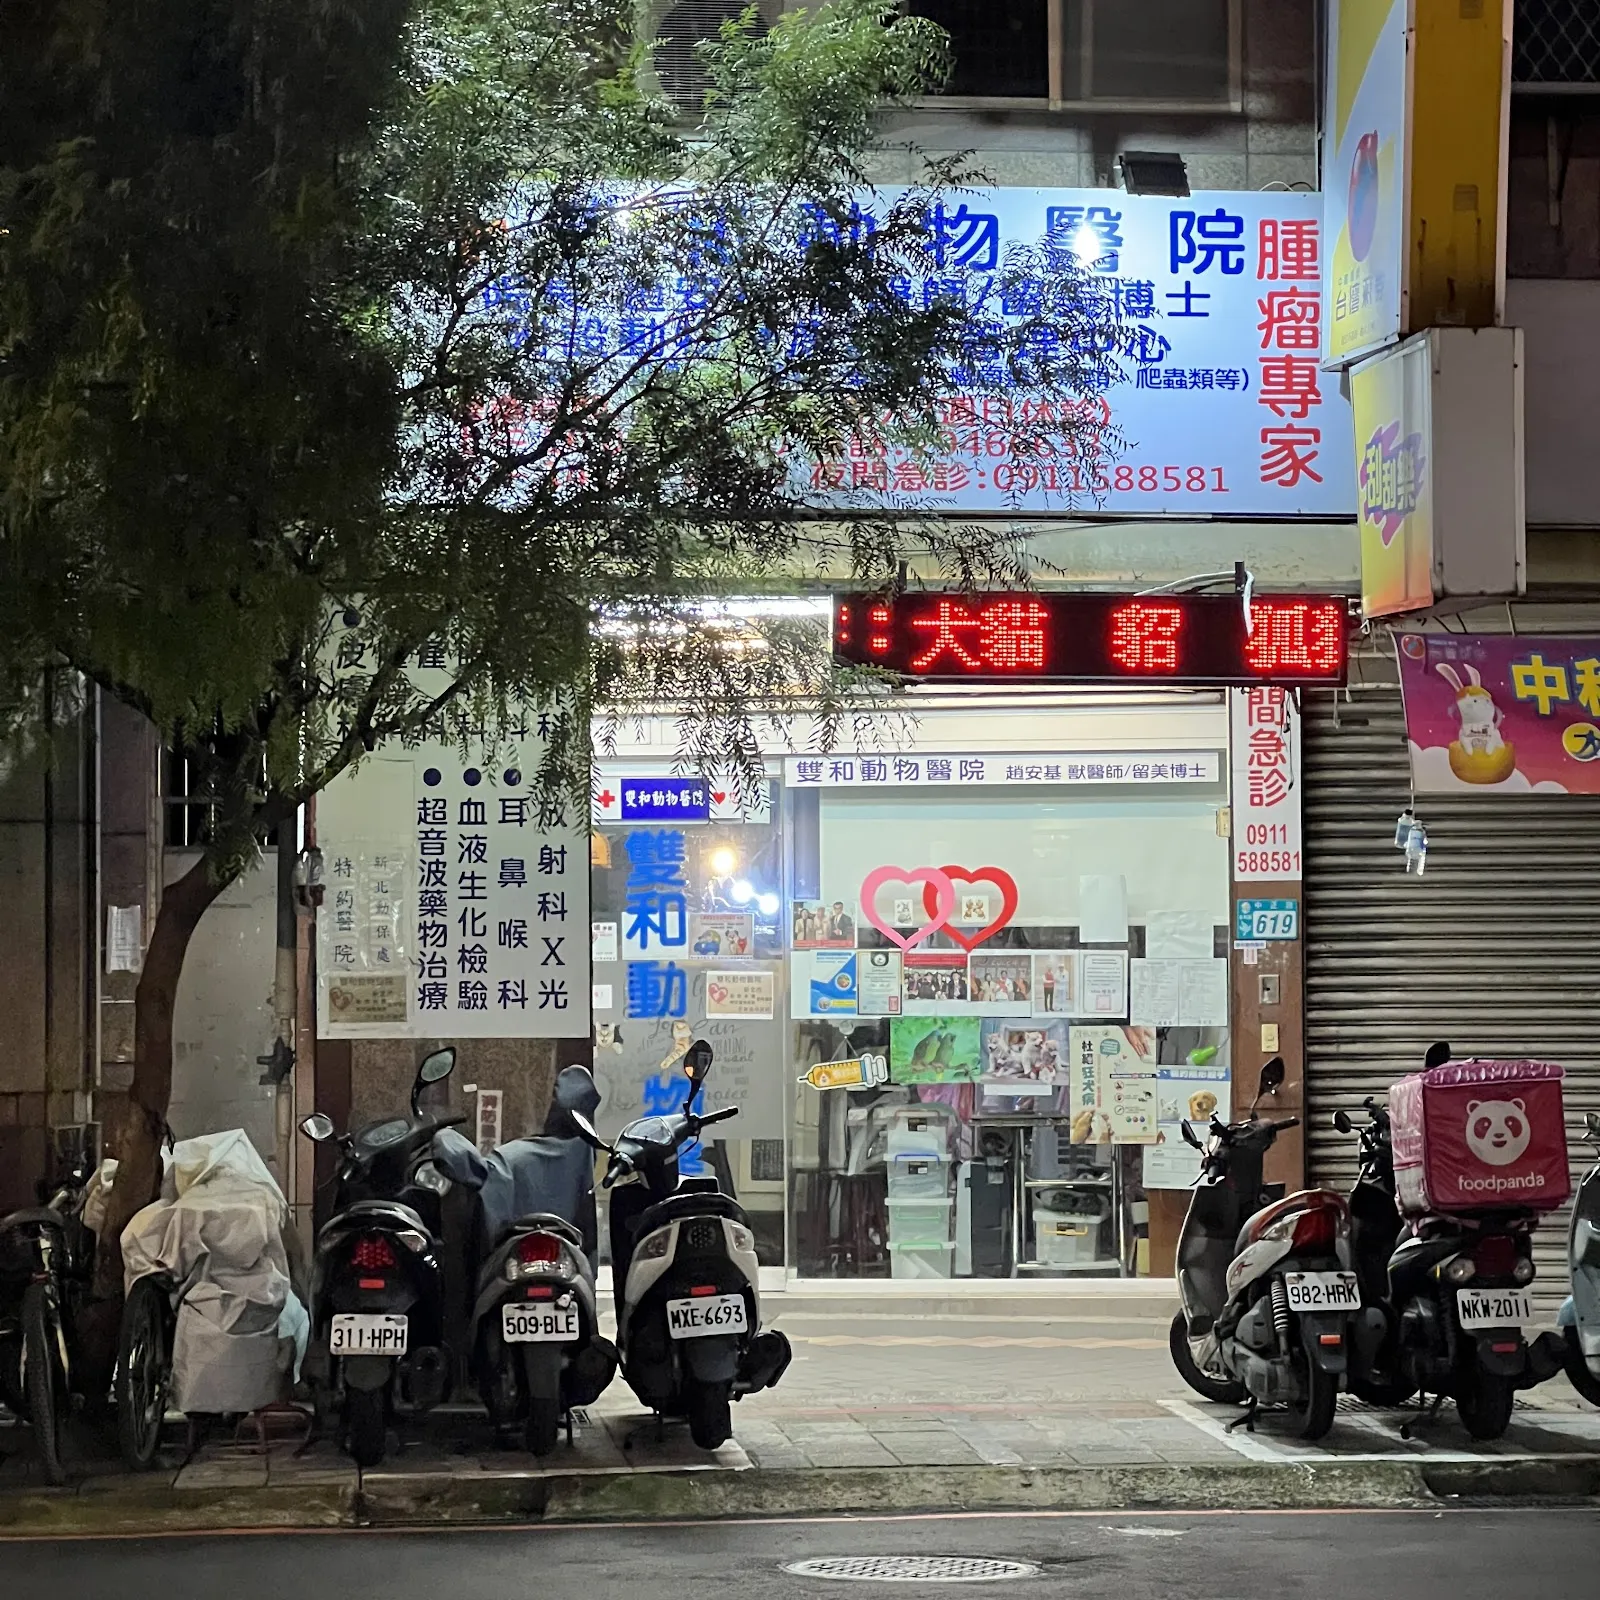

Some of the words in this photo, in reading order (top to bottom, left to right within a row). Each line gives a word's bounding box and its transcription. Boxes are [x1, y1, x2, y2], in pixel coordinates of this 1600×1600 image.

[1257, 218, 1323, 488] 腫瘤專家
[797, 759, 985, 782] 雙和動物醫院
[1006, 764, 1062, 780] 趙安基
[1068, 763, 1207, 780] 獸醫師/留美博士
[625, 790, 705, 807] 雙和動物醫院
[1247, 824, 1288, 845] 0911
[1238, 852, 1301, 872] 588581
[333, 857, 355, 964] 特約醫院
[418, 797, 448, 1011] 超音波藥物治療
[457, 798, 488, 1011] 血液生化檢驗
[497, 797, 528, 1010] 耳鼻喉科
[1256, 914, 1293, 934] 619
[1458, 1172, 1545, 1195] foodpanda
